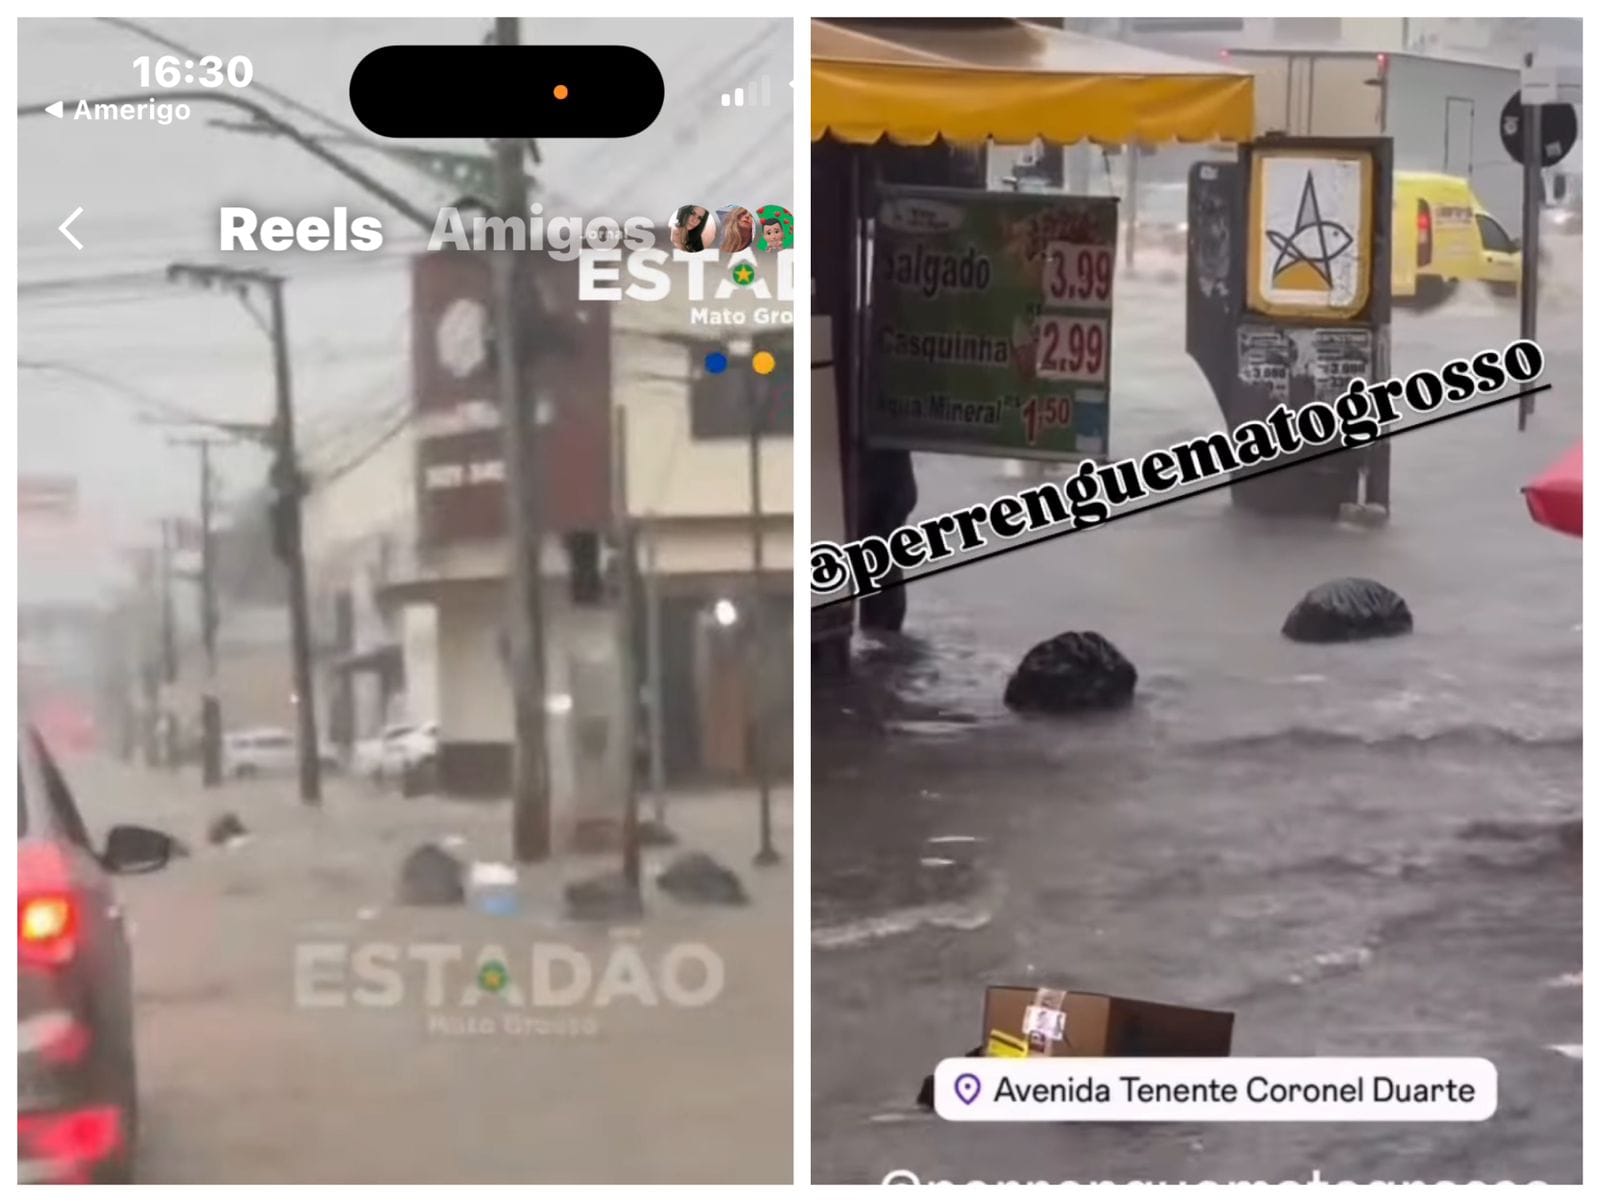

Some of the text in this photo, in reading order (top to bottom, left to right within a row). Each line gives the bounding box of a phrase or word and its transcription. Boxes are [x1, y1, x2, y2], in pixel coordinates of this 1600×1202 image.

[1050, 250, 1111, 299] 3.99
[1040, 321, 1104, 374] 2.99
[929, 394, 1001, 424] Mineral
